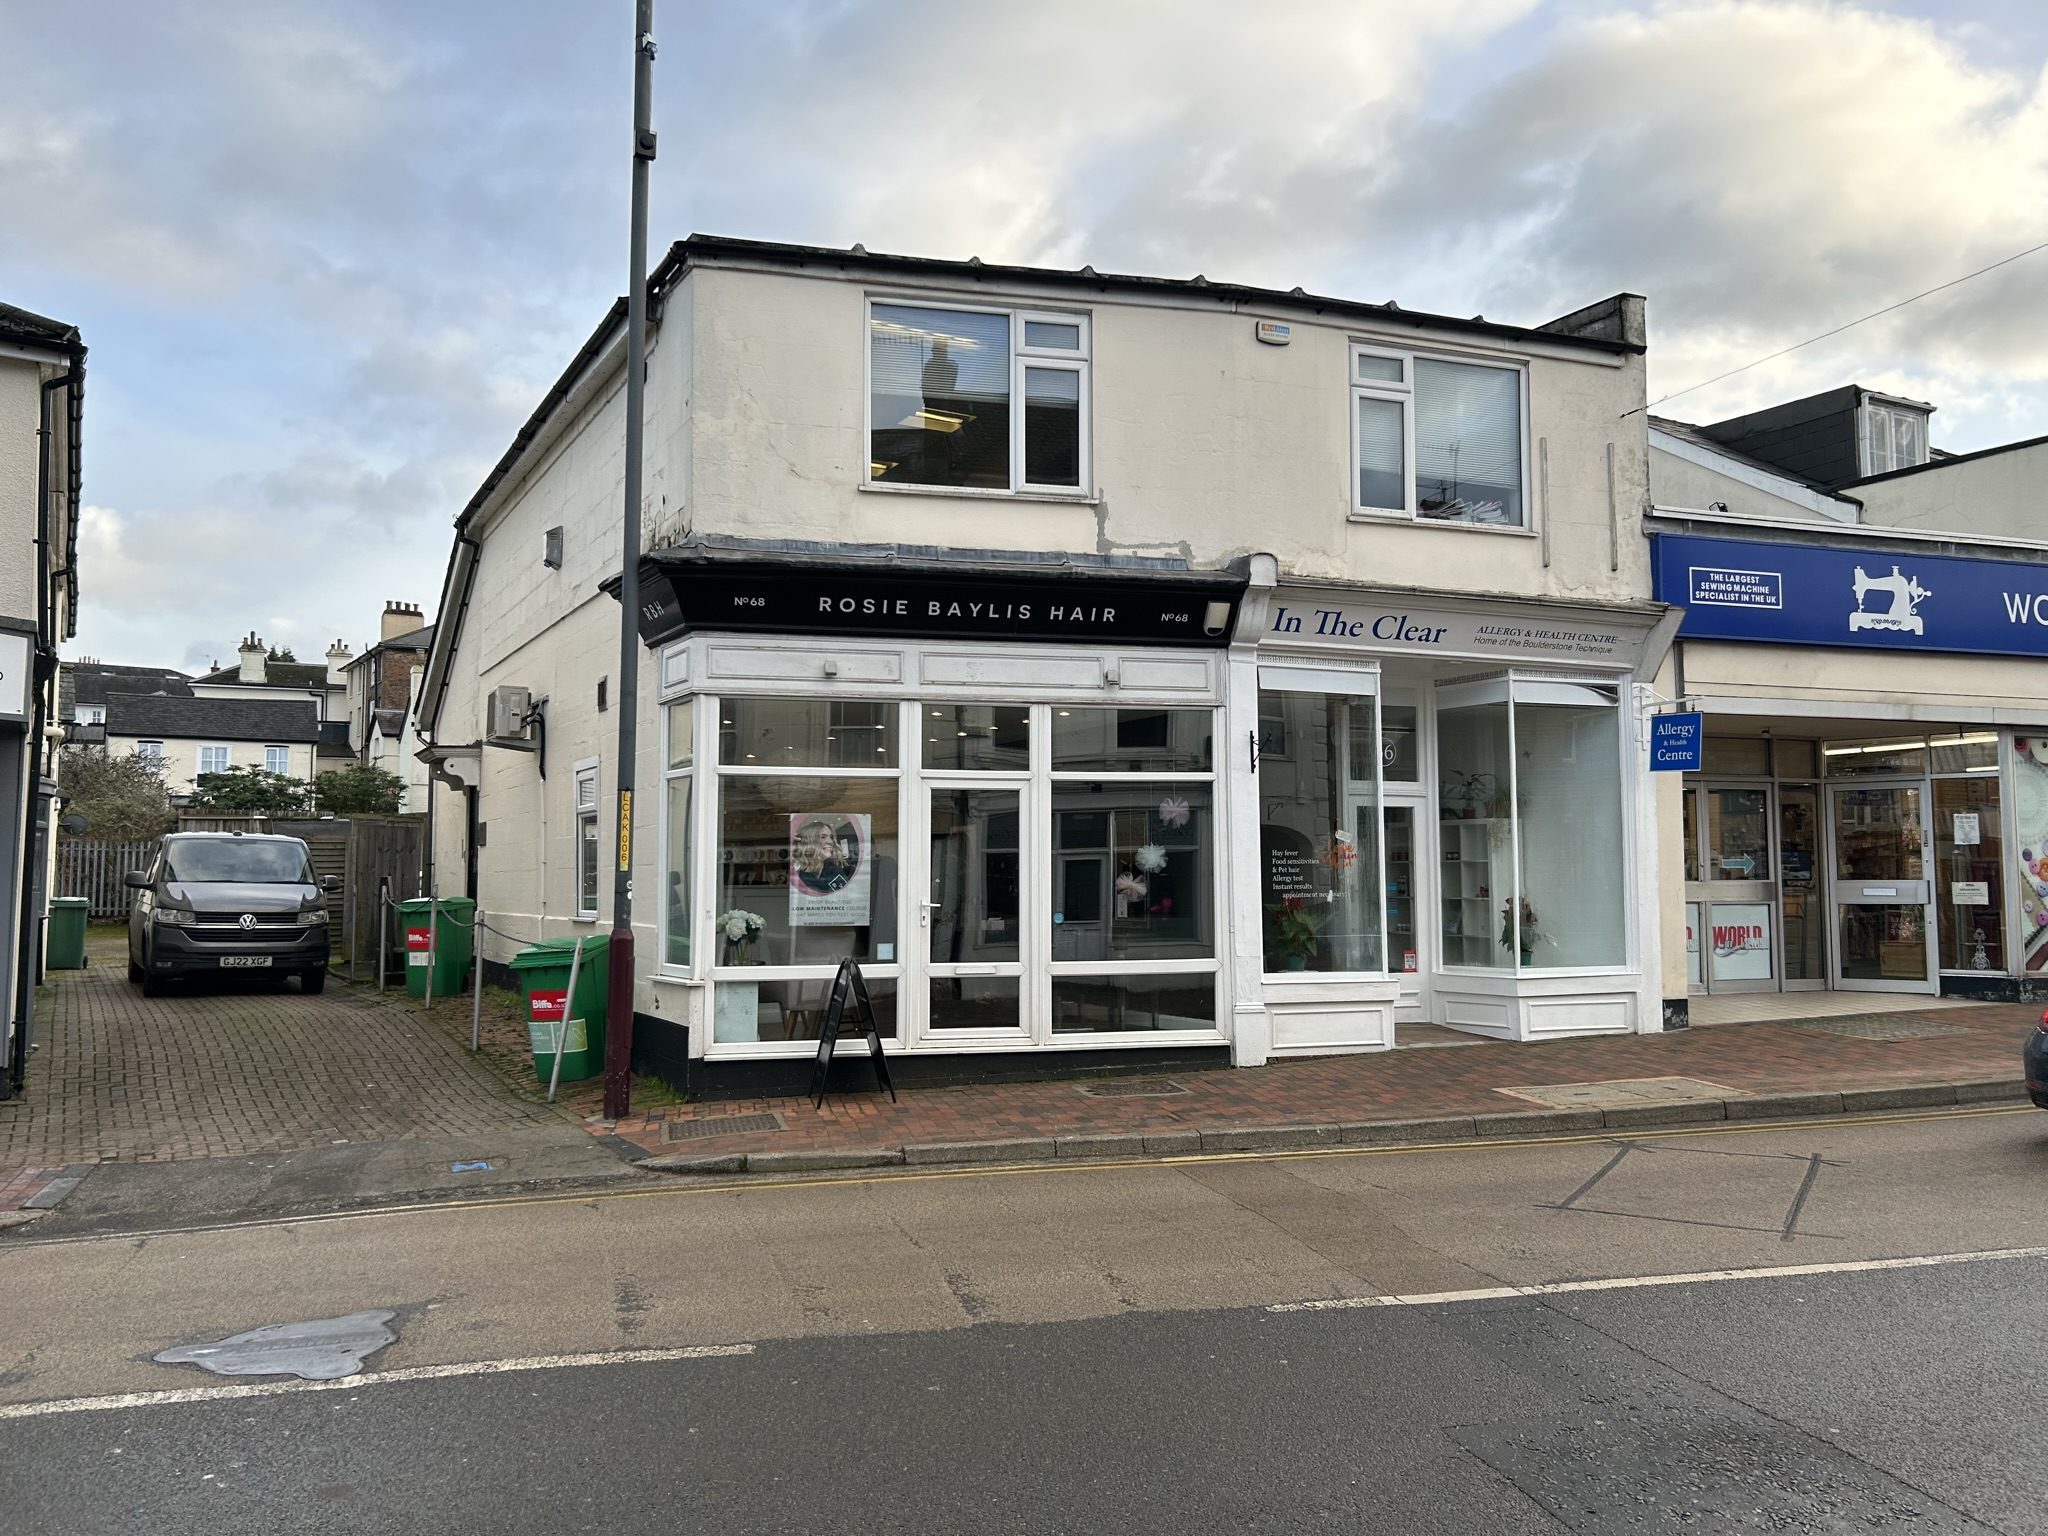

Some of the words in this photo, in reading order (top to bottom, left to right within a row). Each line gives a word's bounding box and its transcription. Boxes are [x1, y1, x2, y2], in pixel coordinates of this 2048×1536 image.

[1710, 573, 1724, 581] THE
[1726, 574, 1760, 584] LARGEST
[1701, 582, 1732, 591] SEWING
[1734, 584, 1769, 594] MACHINE
[1696, 591, 1739, 601] SPECIALIST
[1741, 594, 1749, 602] IN
[1751, 595, 1764, 603] THE
[1766, 596, 1776, 604] UK
[642, 601, 665, 622] RBH
[819, 597, 908, 615] ROSIE
[928, 601, 1031, 619] BAYLIS
[1050, 606, 1116, 622] HAIR
[1271, 608, 1302, 633] In
[1314, 610, 1364, 637] The
[1372, 615, 1448, 644] Clear
[1477, 626, 1524, 637] ALLERGY
[1525, 630, 1532, 638] &
[1535, 630, 1576, 641] HEALTH
[1578, 634, 1618, 644] CENTRE
[1474, 636, 1497, 645] Home
[1499, 638, 1508, 646] of
[1509, 638, 1521, 647] the
[1523, 640, 1573, 651] Boulderstone
[1576, 644, 1613, 654] Technique
[1656, 723, 1695, 738] Allergy
[1657, 749, 1693, 761] Centre
[622, 794, 630, 832] LCAK
[224, 958, 249, 966] GJ22
[251, 958, 269, 966] XGF
